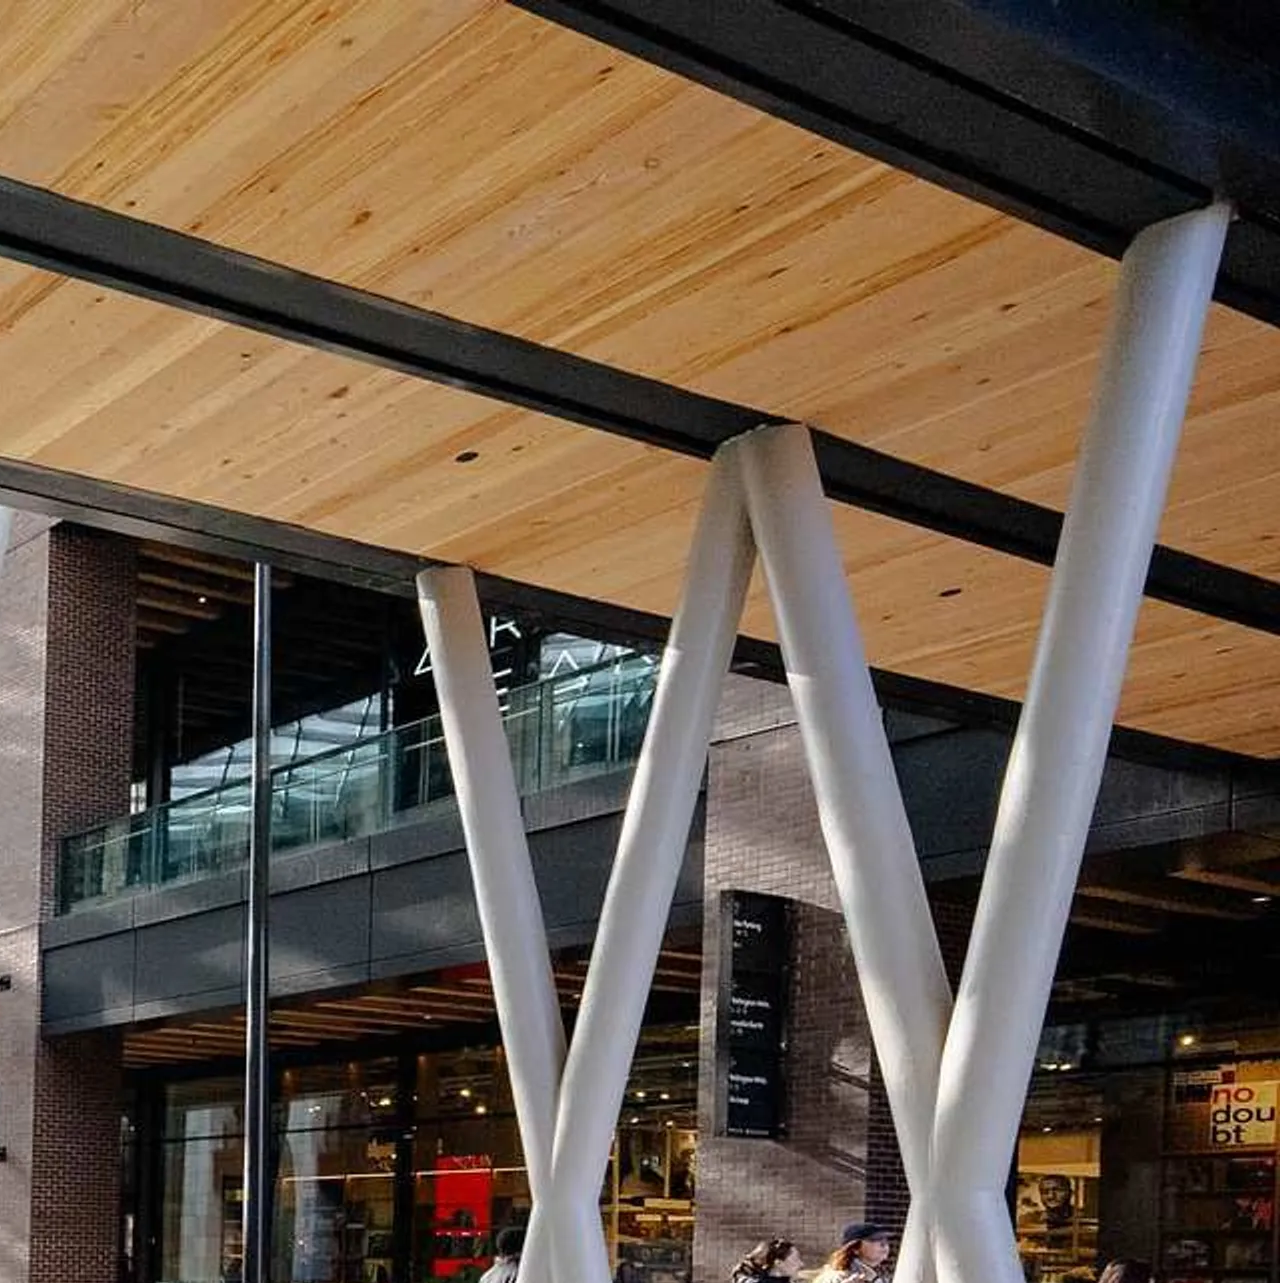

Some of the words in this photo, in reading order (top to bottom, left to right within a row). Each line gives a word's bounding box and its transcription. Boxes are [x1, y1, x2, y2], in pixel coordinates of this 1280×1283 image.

[1213, 1087, 1255, 1104] no
[1212, 1104, 1275, 1124] dou
[1212, 1124, 1247, 1144] bt
